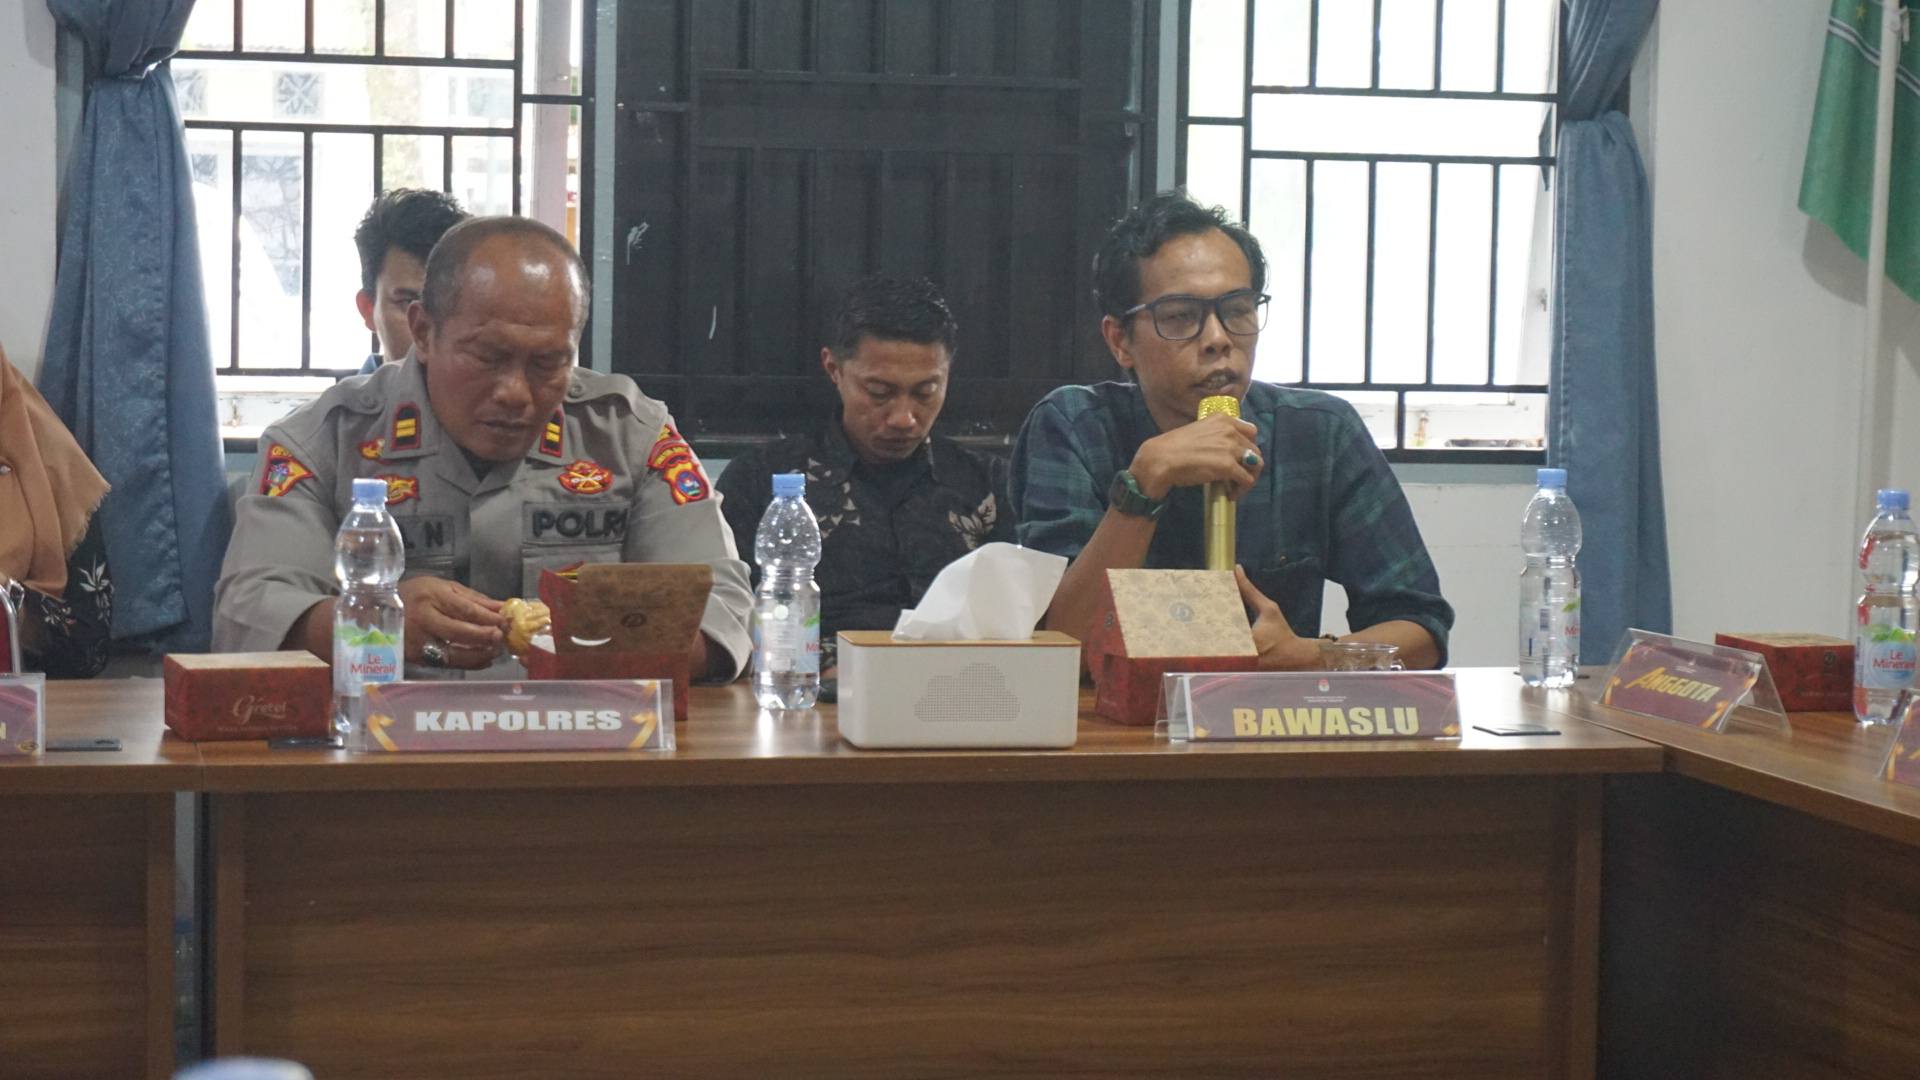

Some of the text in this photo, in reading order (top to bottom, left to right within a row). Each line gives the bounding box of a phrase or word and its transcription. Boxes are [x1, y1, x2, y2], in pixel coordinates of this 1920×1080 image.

[367, 653, 384, 664] Le
[1624, 667, 1720, 702] ANGGOTA
[415, 710, 622, 731] KAPOLRES
[1232, 706, 1419, 737] BAWASLU
